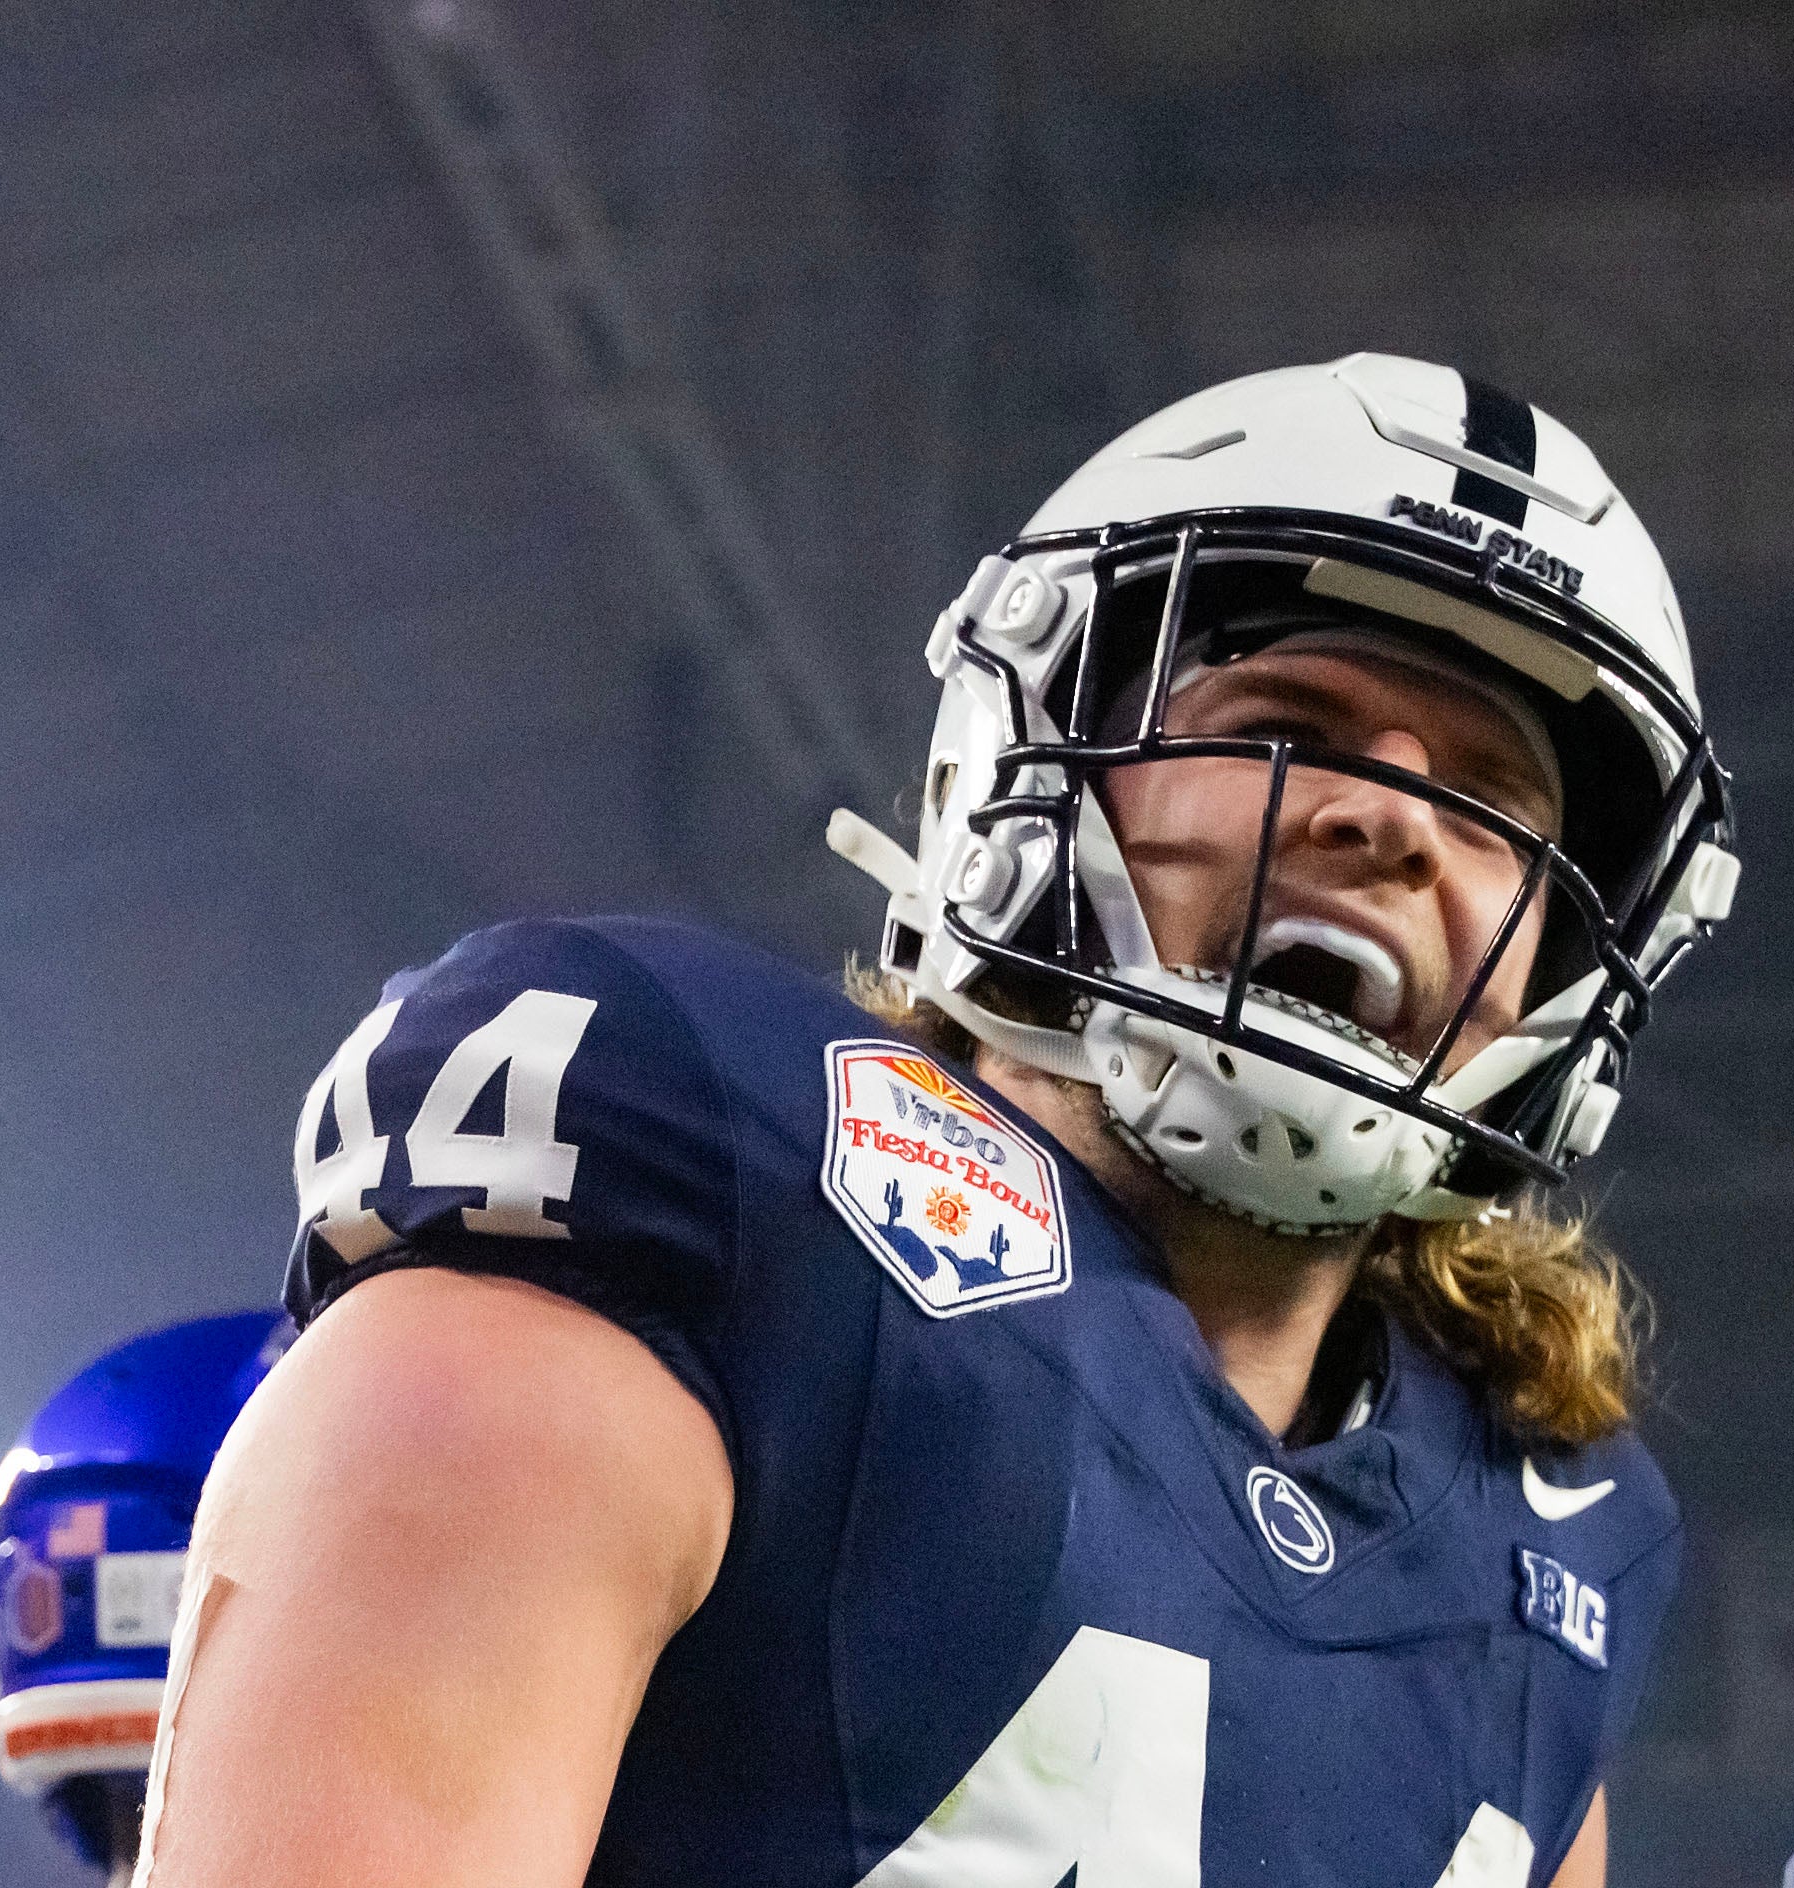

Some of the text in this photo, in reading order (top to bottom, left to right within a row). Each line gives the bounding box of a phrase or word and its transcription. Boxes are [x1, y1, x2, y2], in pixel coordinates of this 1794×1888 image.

[1388, 493, 1586, 597] PENN STATE
[294, 988, 598, 1266] 44
[842, 1116, 1055, 1233] Fiesta Bowl
[887, 1077, 1007, 1168] Vrbo
